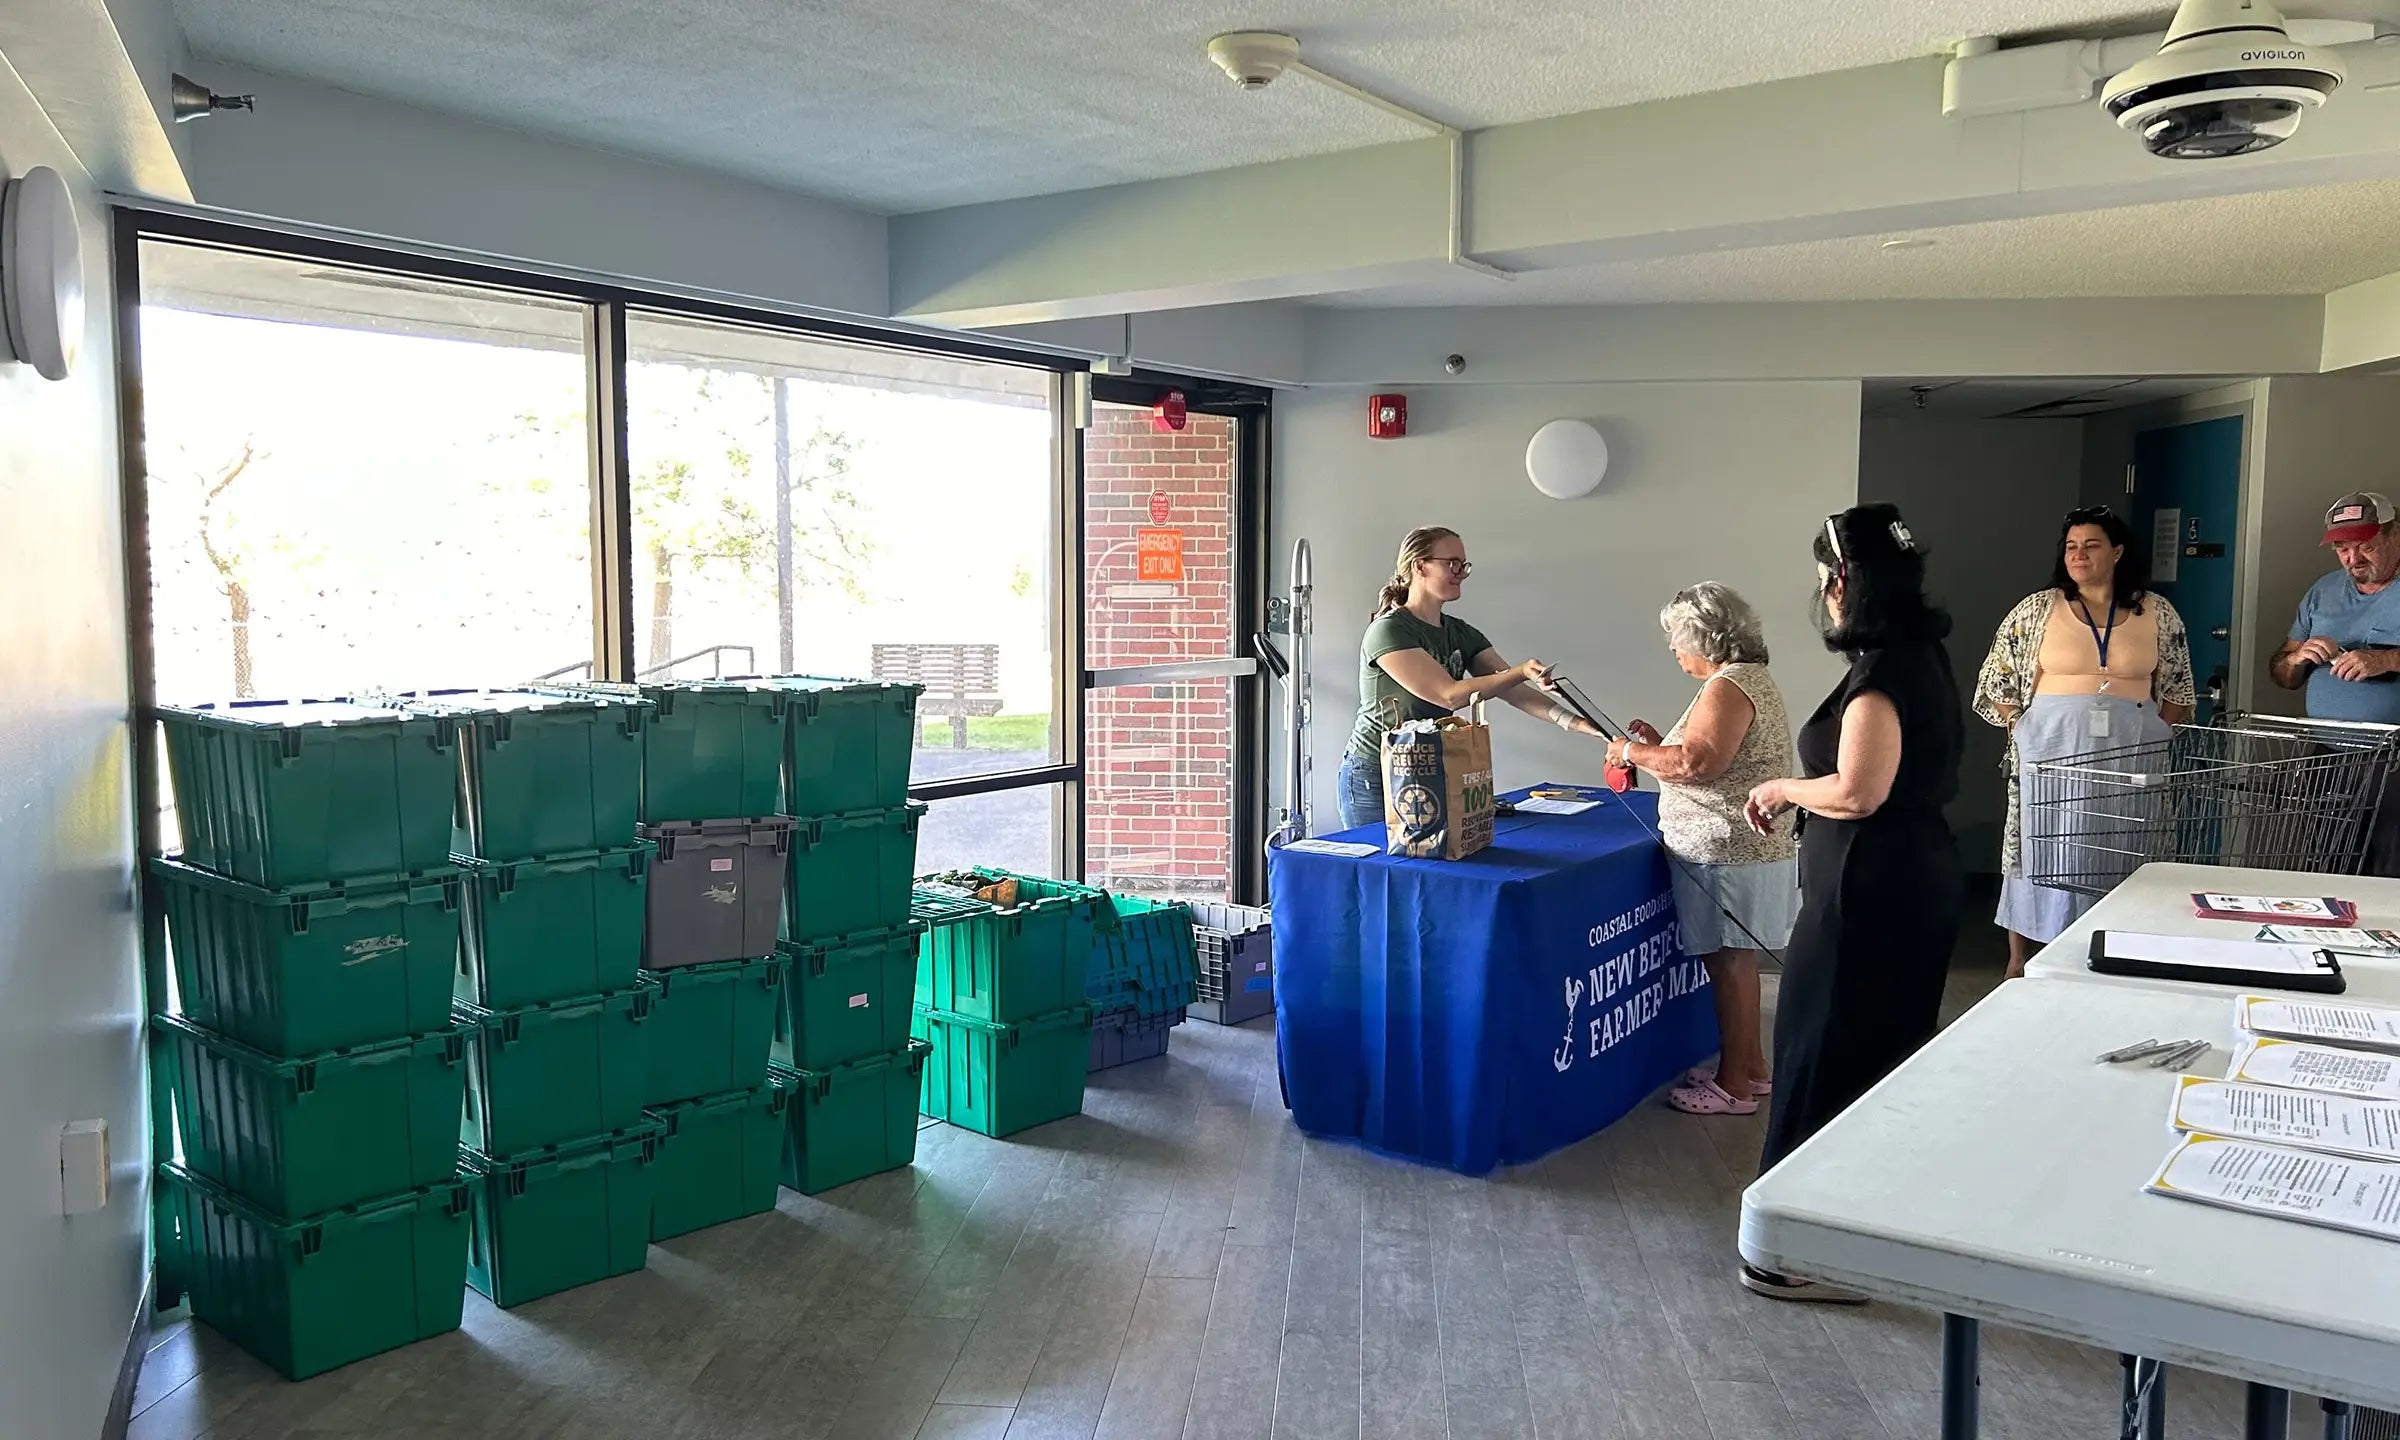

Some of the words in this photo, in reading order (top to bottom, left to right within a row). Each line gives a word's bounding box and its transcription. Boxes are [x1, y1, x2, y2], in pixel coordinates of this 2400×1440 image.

[1139, 533, 1181, 551] EMERGENCY
[1143, 556, 1159, 574] EXIT
[1159, 555, 1176, 574] ONLY
[1391, 743, 1436, 753] REDUCE
[1392, 753, 1437, 767] REUSE
[1393, 766, 1437, 777] RECYCLE
[1588, 911, 1633, 948] COASTAL
[1589, 948, 1635, 1007] NEW
